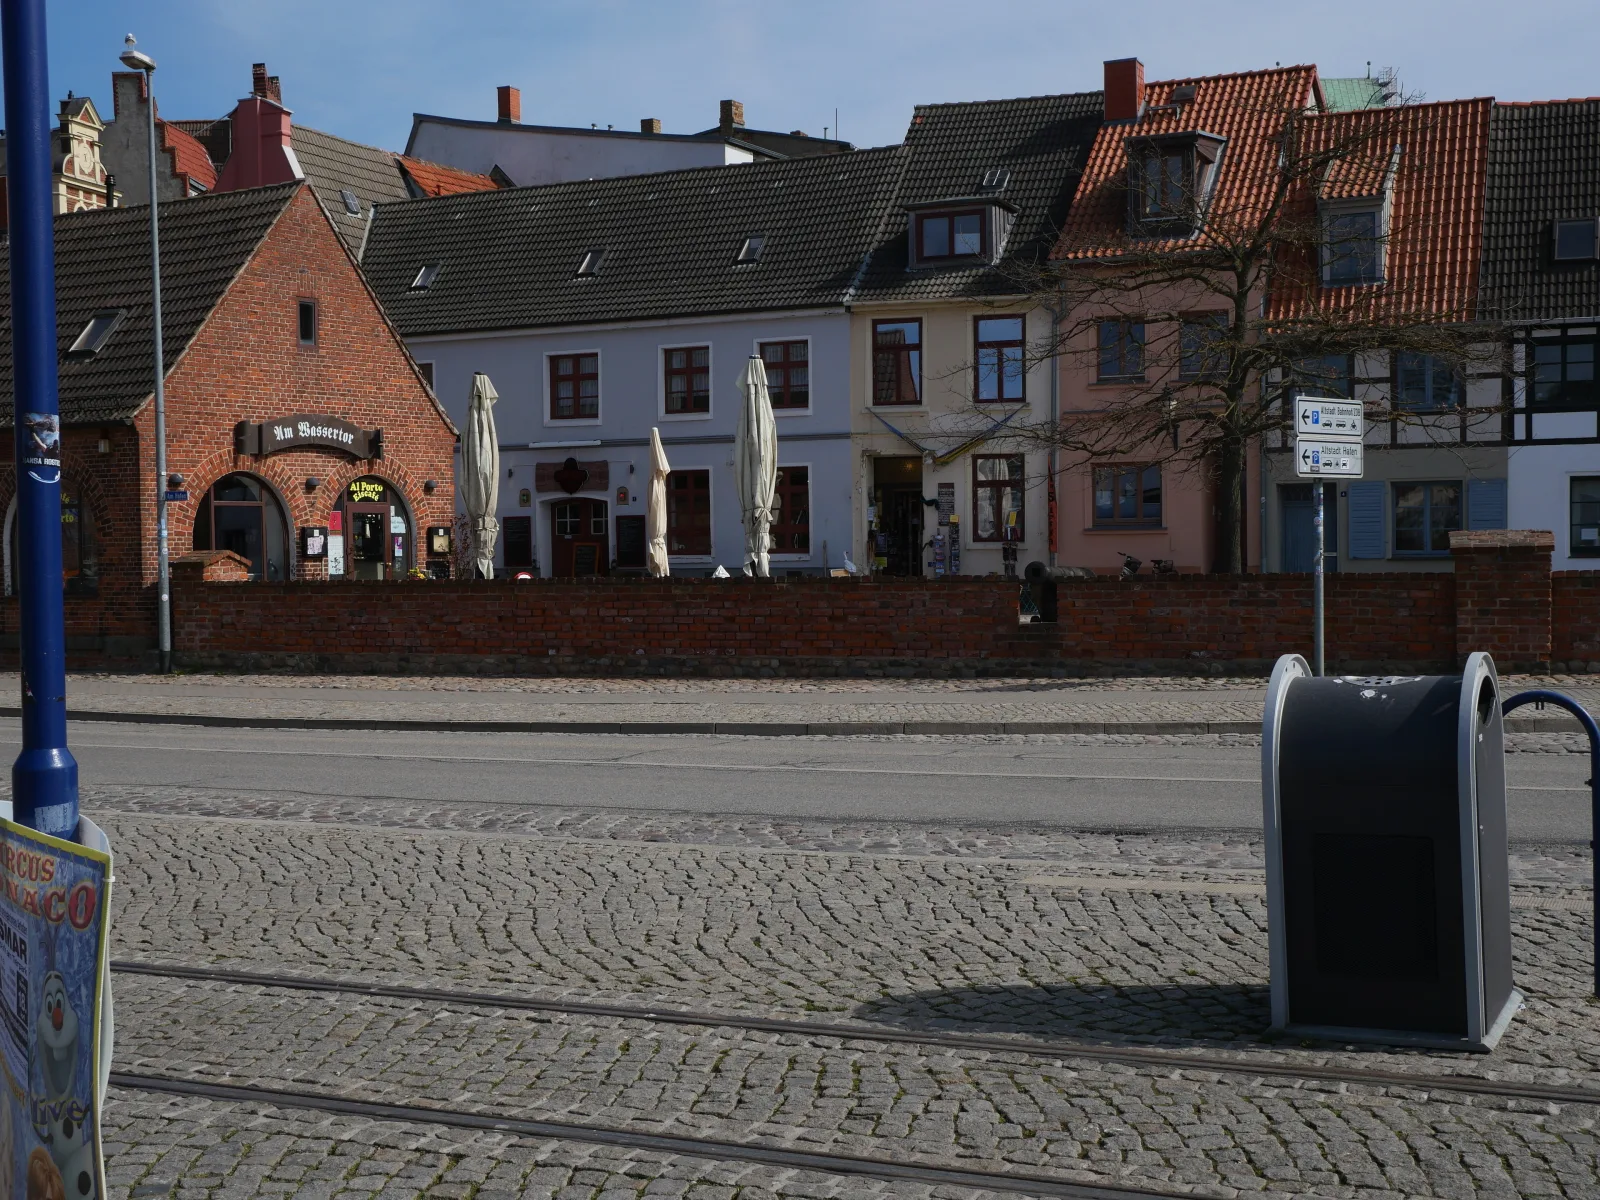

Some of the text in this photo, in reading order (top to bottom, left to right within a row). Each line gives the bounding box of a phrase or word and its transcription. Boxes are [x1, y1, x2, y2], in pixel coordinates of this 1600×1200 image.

[1321, 406, 1336, 415] Altstadt
[273, 421, 354, 445] Am Wassertor
[1320, 446, 1341, 455] Altstadt
[1342, 446, 1358, 456] Hafen
[350, 481, 384, 492] Al Porto
[352, 490, 380, 502] Eiscafé
